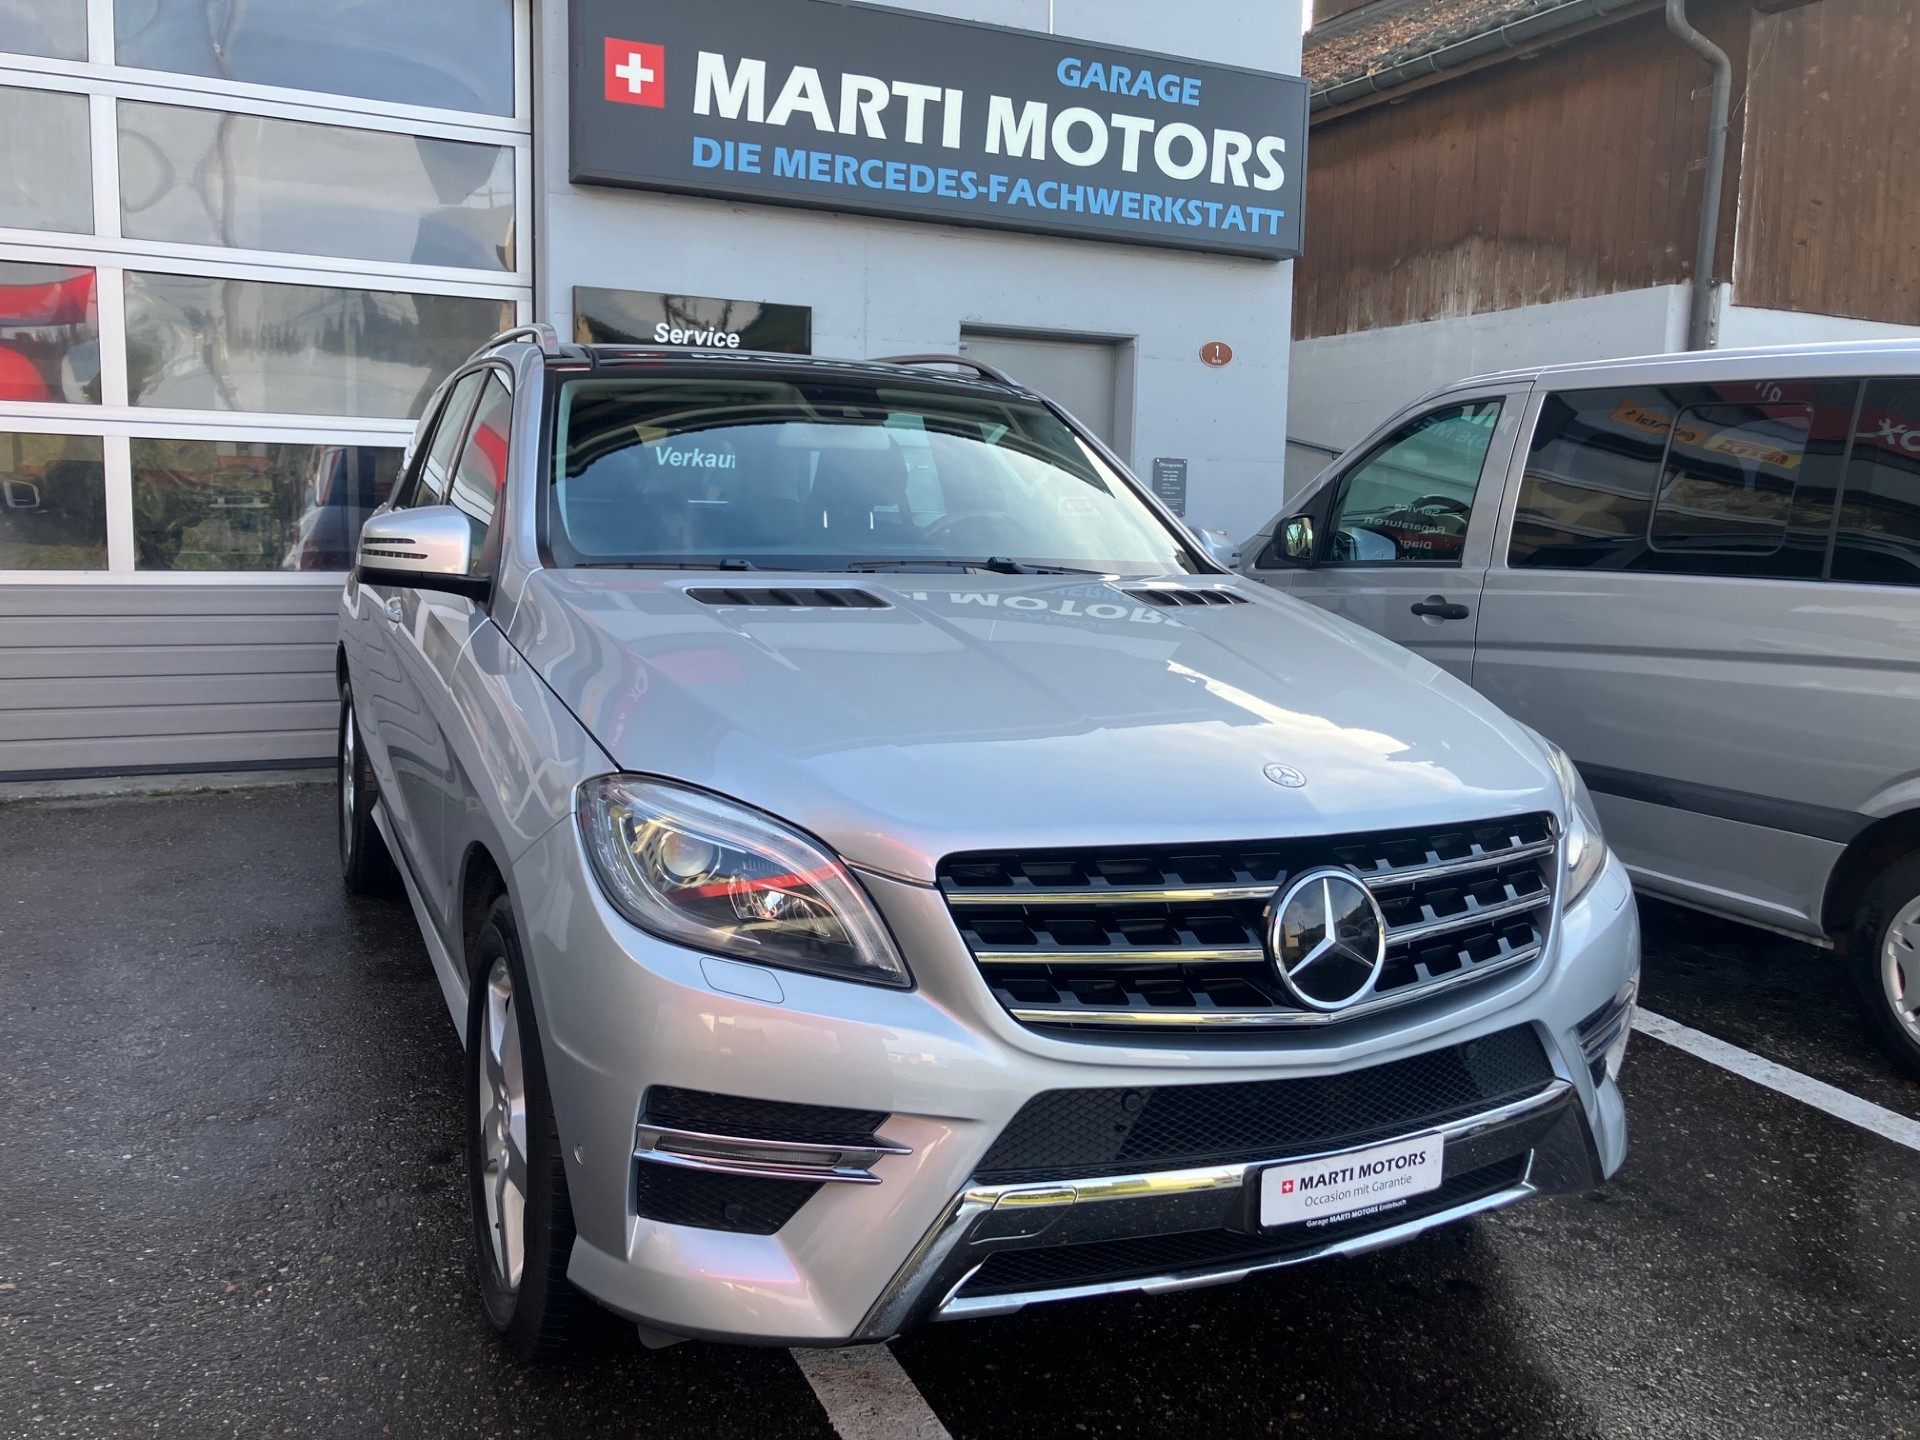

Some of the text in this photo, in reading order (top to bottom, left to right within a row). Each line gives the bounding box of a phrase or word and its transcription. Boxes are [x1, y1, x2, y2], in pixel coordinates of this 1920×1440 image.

[1057, 57, 1201, 106] GARAGE
[693, 51, 1286, 191] MARTI MOTORS
[693, 137, 1284, 235] DIE MERCEDES-FACHWERKSTATT
[654, 322, 740, 348] Service
[1299, 1151, 1427, 1191] MARTI MOTORS
[1304, 1174, 1413, 1207] Occasion mit Garantie
[1306, 1217, 1329, 1228] Garage
[1329, 1212, 1351, 1223] MARTI
[1351, 1205, 1379, 1218] MOTORS
